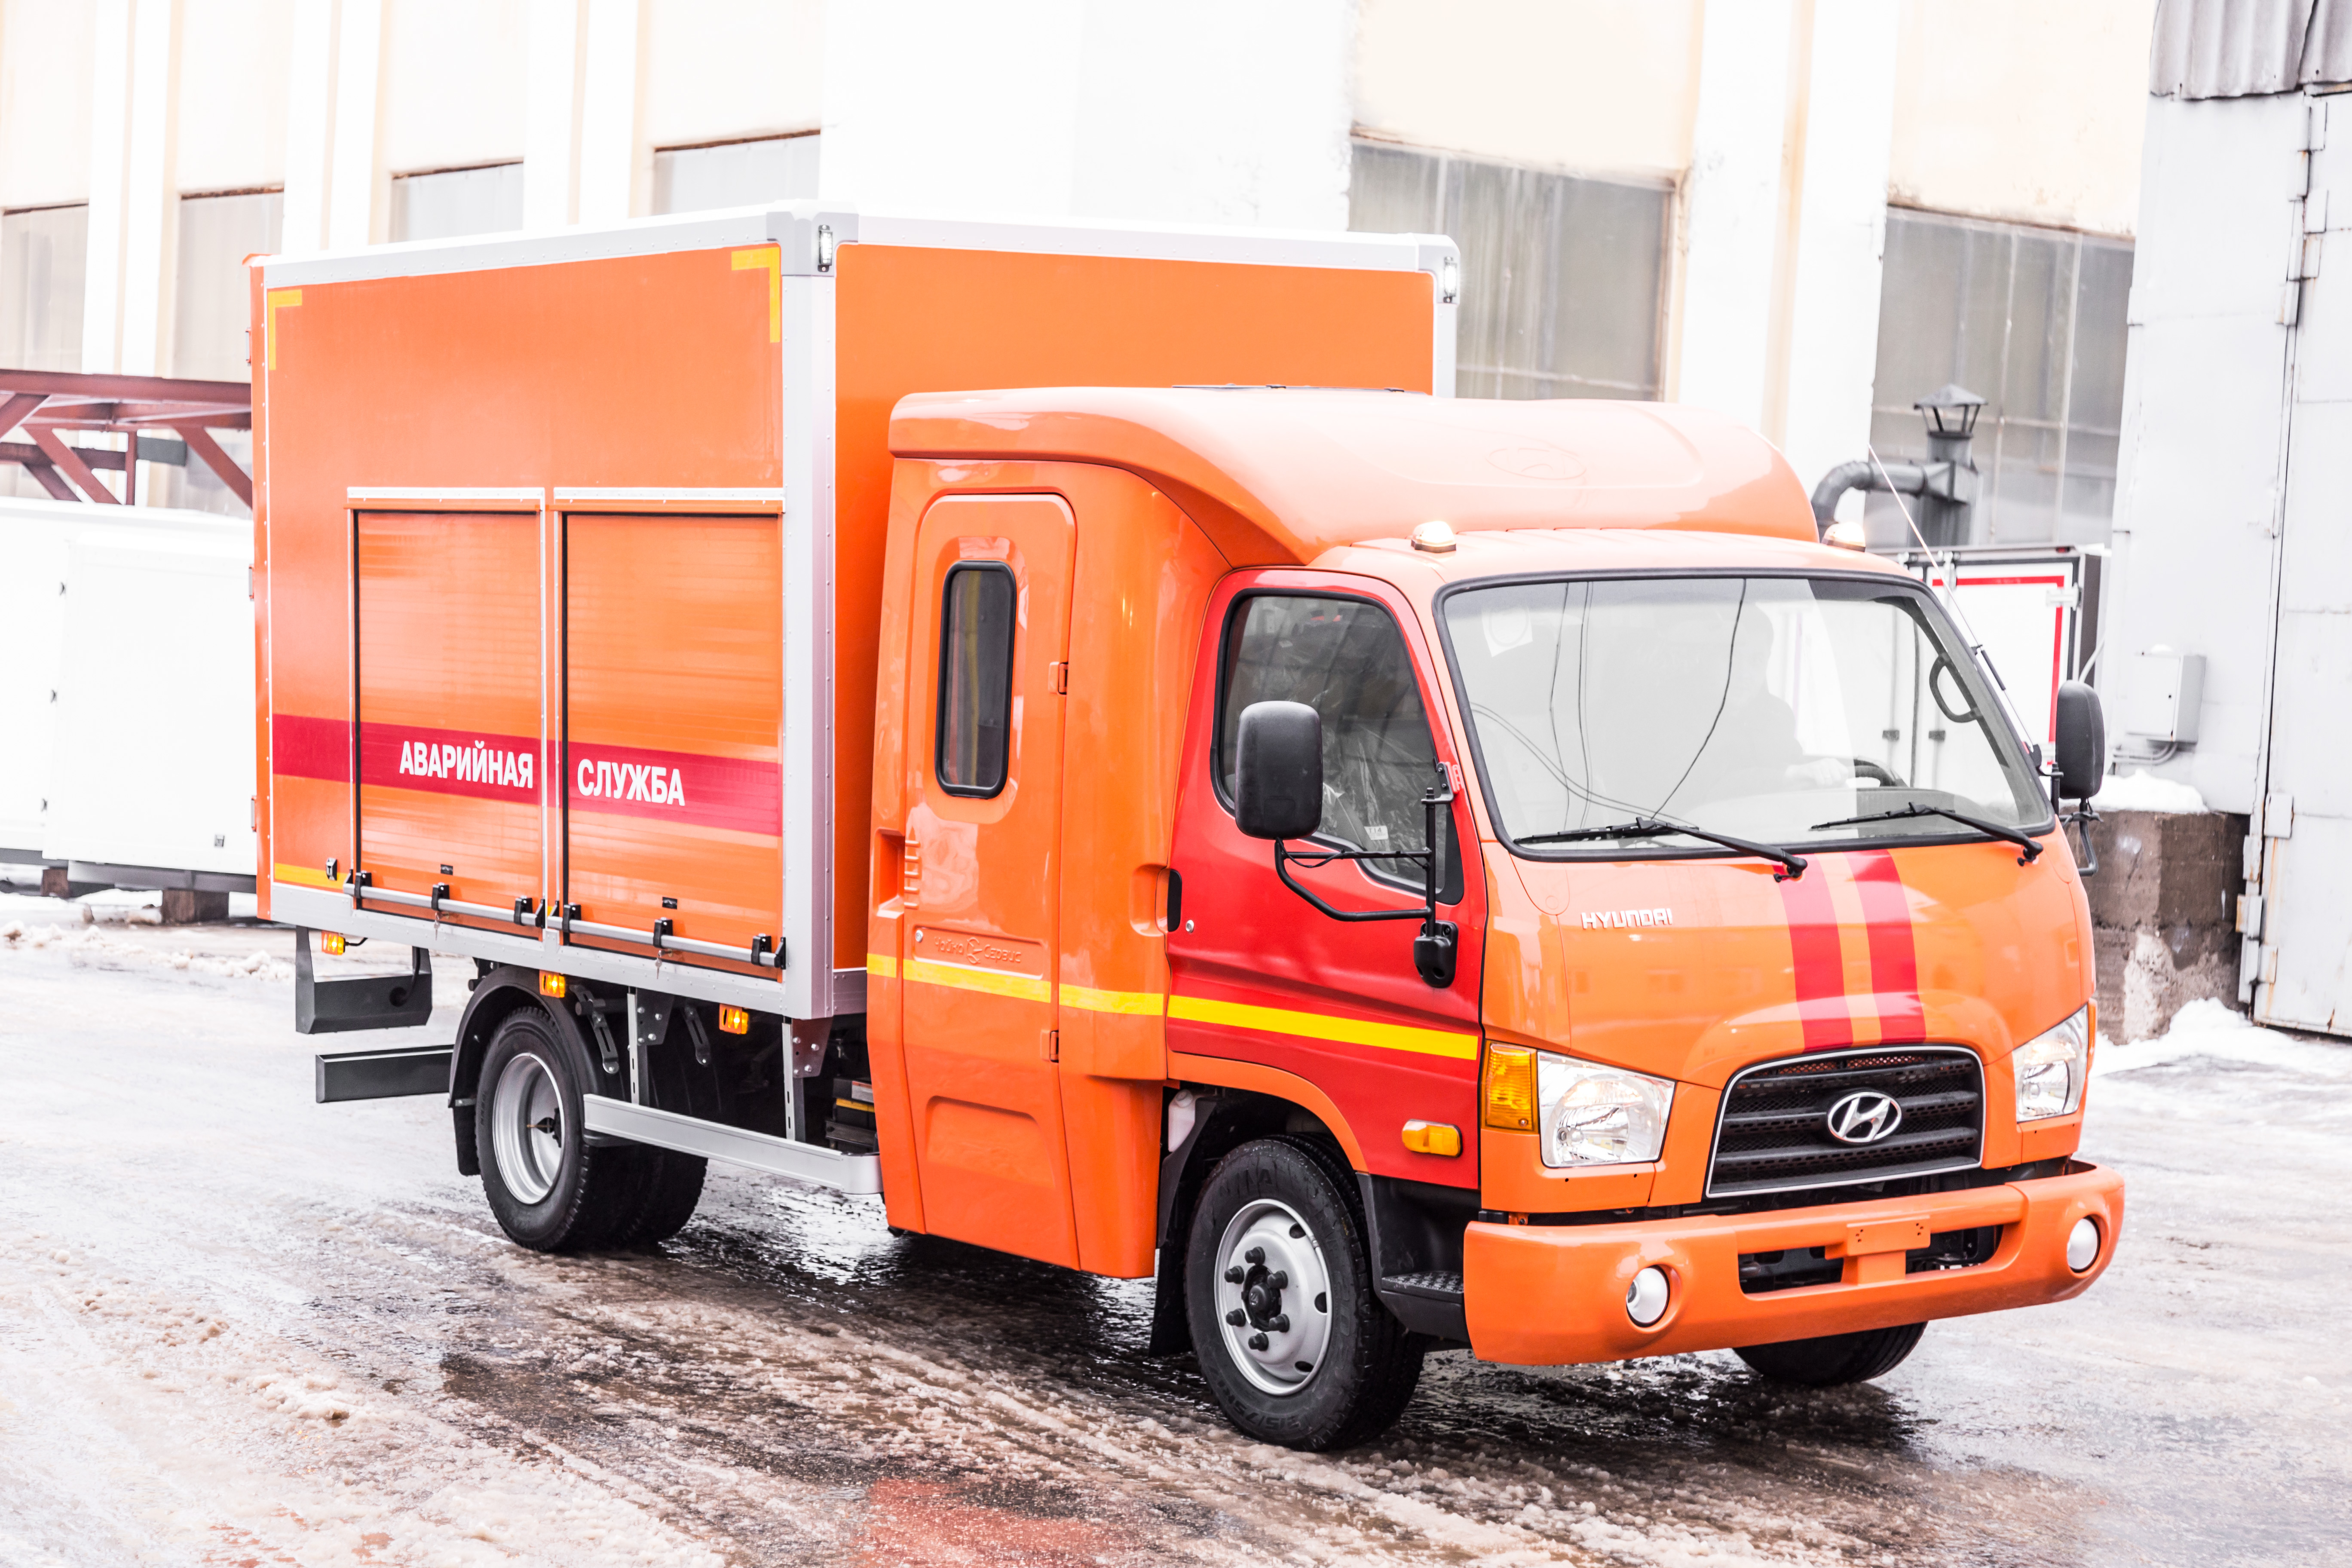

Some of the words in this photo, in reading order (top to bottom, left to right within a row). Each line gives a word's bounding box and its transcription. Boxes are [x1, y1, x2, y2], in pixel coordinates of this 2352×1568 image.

[399, 740, 533, 789] АВАРИЙНАЯ
[577, 759, 686, 807] СЛУЖБА
[1580, 908, 1673, 930] HYUNDAI
